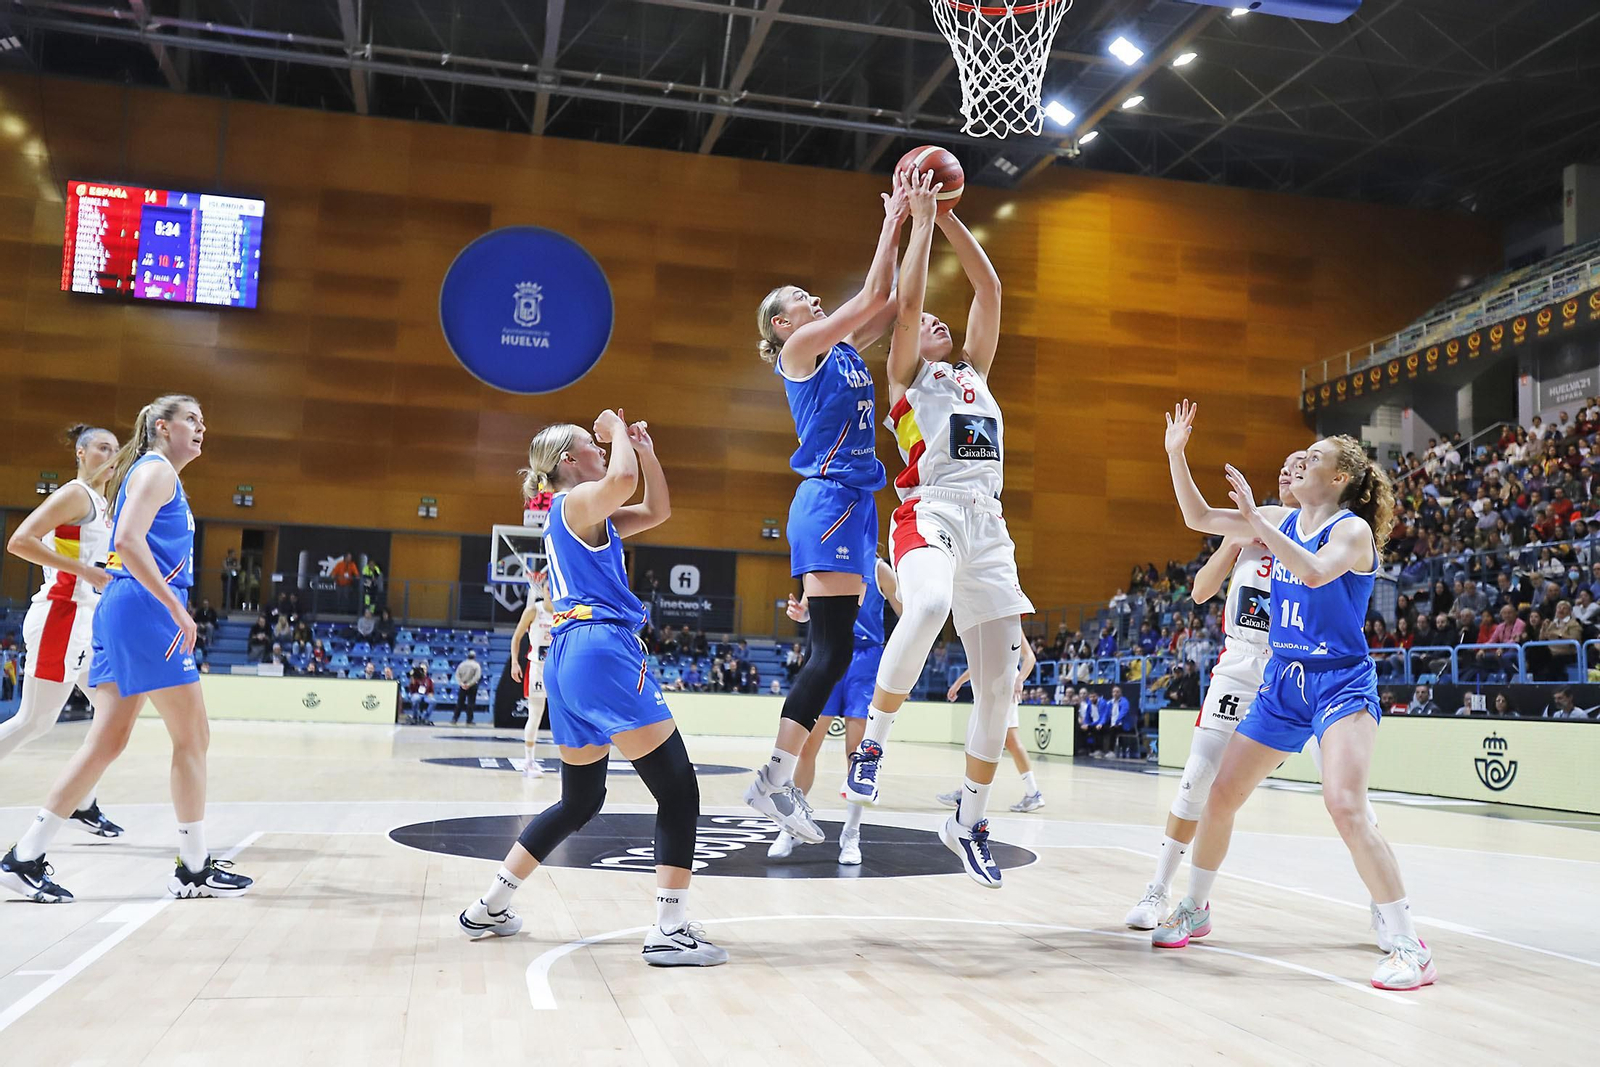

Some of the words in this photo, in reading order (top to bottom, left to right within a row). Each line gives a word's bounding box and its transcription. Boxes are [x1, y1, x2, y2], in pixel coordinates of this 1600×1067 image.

[88, 186, 128, 199] ESPAÑA
[144, 189, 157, 204] 14
[179, 193, 188, 207] 4
[501, 334, 550, 349] HUELVA
[678, 571, 692, 589] fi
[1280, 598, 1305, 632] 14
[1218, 694, 1240, 716] fi
[1212, 711, 1240, 723] network
